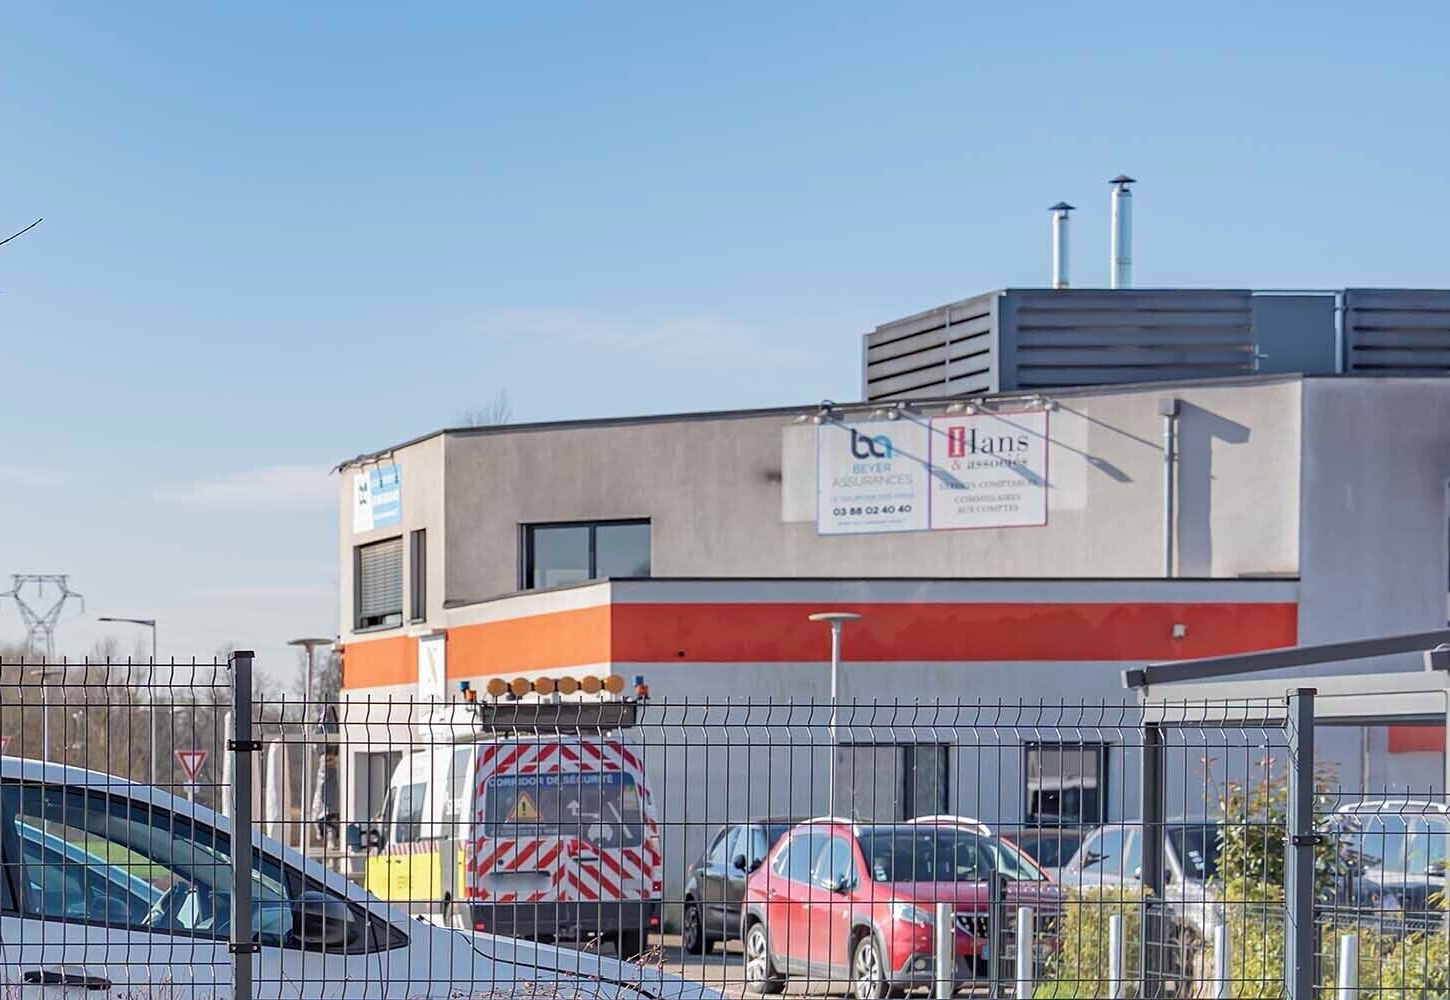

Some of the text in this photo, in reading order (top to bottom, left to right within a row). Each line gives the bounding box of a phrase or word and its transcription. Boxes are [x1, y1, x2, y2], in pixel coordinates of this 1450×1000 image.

[852, 463, 892, 475] BEYER
[966, 454, 1028, 471] associés
[832, 474, 914, 488] ASSURANCES
[832, 504, 912, 517] 03 88 02 40 40
